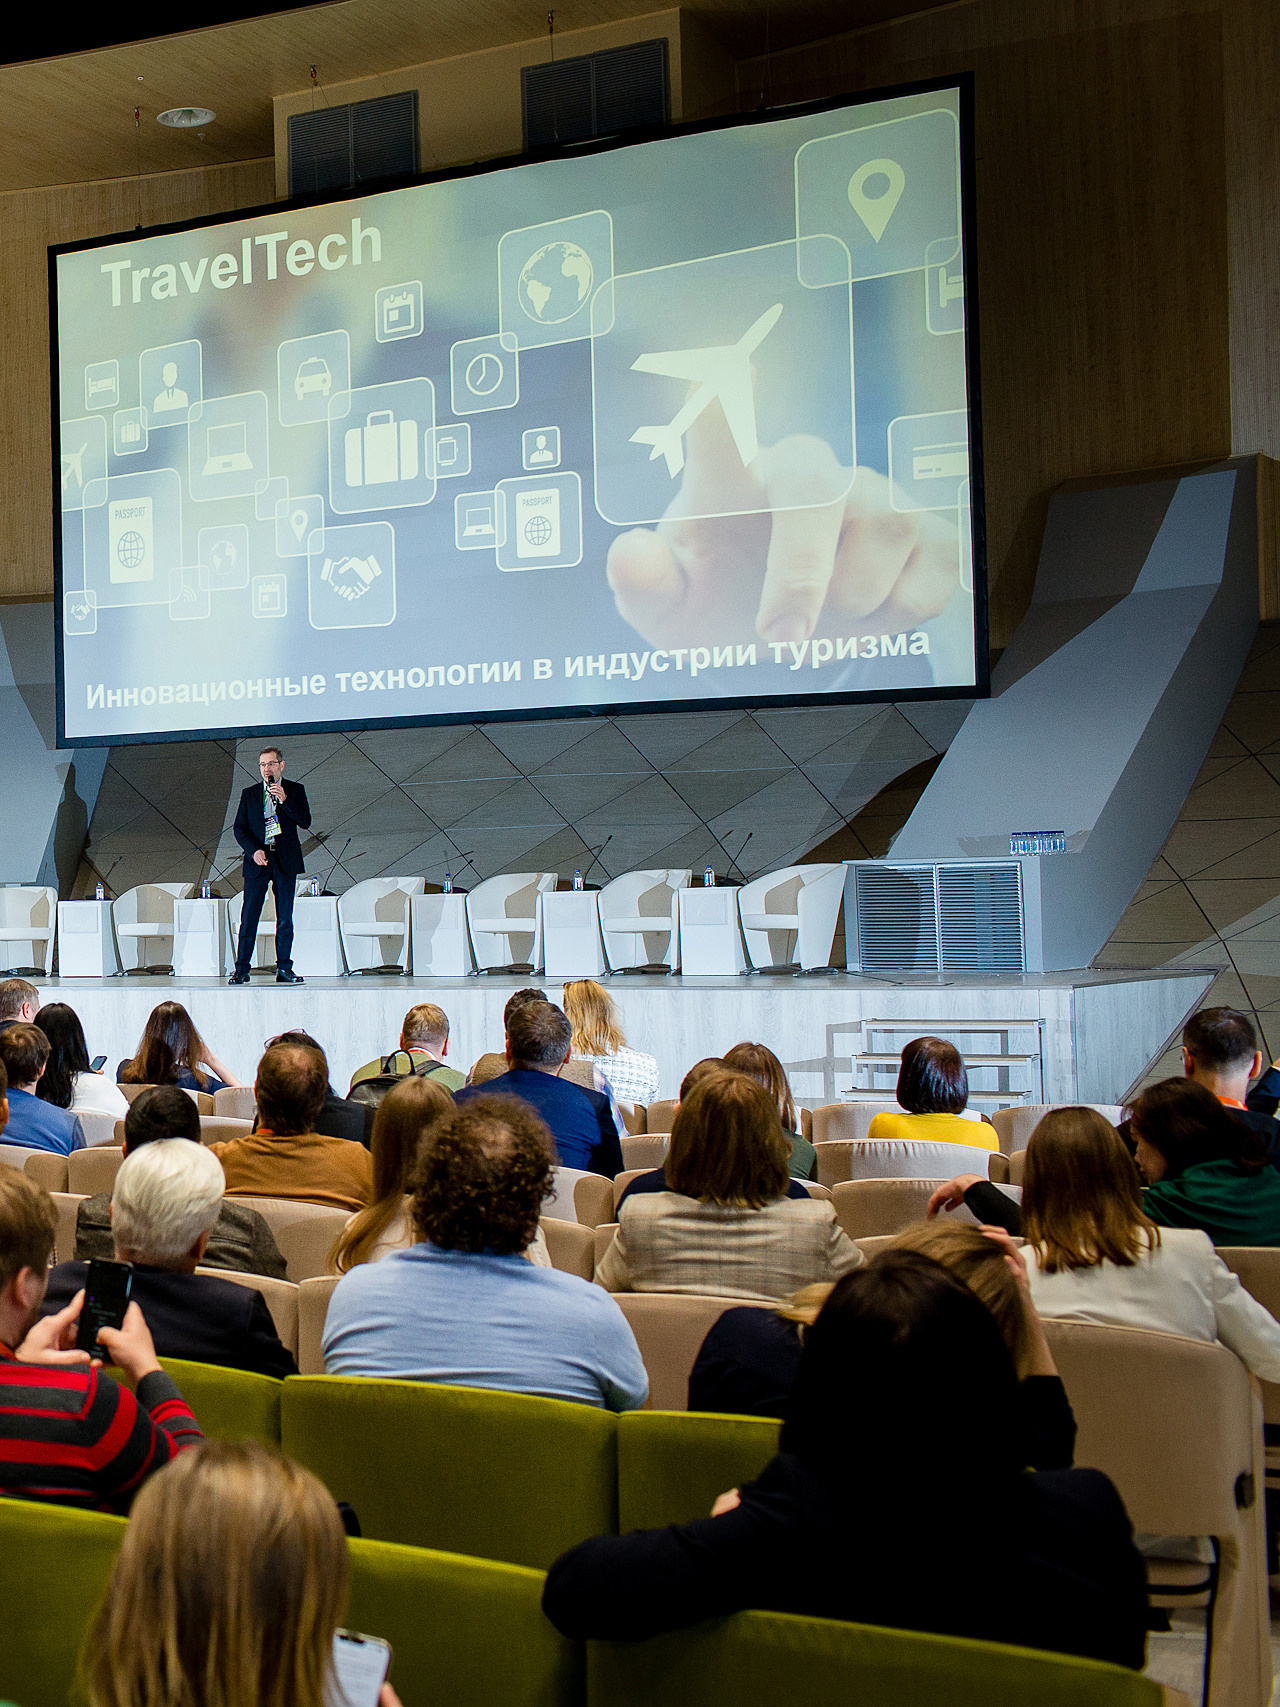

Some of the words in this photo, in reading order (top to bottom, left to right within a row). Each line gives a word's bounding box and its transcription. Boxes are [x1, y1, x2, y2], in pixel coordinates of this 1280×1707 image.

[100, 217, 382, 307] TravelTech
[114, 506, 146, 520] PASSPORT
[522, 495, 552, 507] PASSPORT
[86, 675, 326, 709] Инновационные
[336, 661, 521, 693] технологии
[533, 656, 553, 680] в
[564, 641, 757, 679] индустрии
[768, 630, 931, 670] туризма
